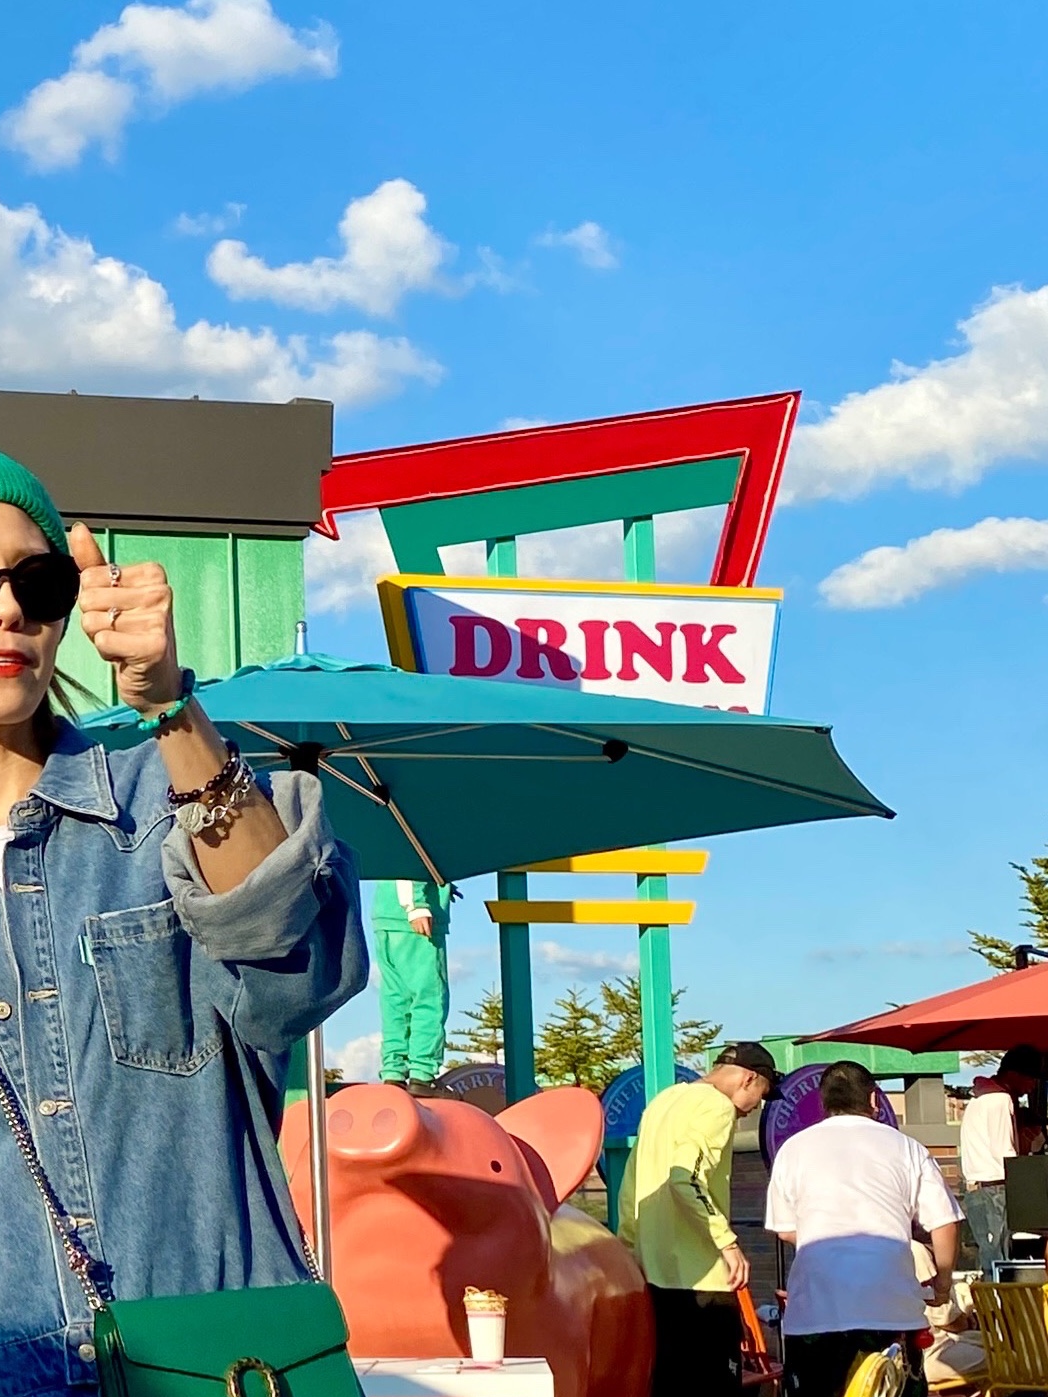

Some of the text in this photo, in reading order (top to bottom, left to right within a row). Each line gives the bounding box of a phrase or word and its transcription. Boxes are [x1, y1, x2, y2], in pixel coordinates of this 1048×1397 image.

[448, 615, 747, 684] DRINK
[454, 1073, 497, 1095] RRY
[605, 1079, 644, 1126] CHER
